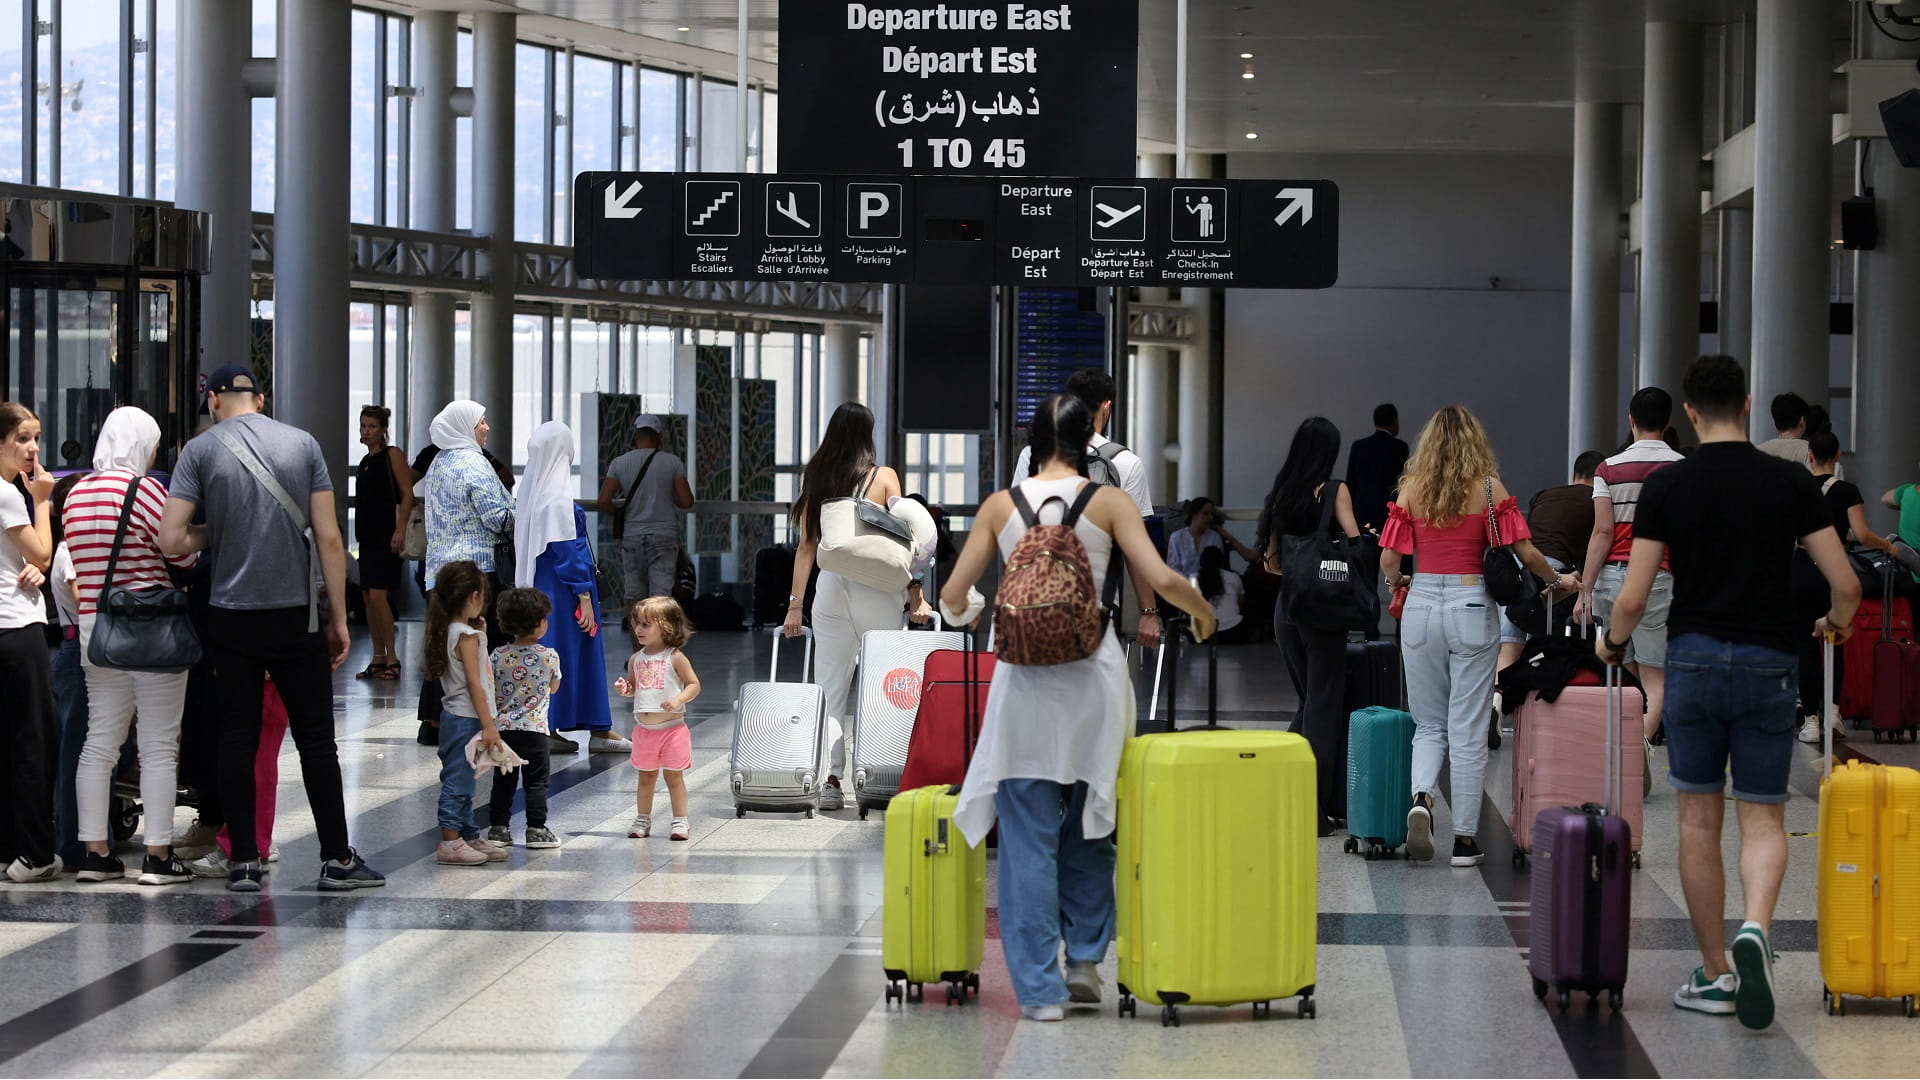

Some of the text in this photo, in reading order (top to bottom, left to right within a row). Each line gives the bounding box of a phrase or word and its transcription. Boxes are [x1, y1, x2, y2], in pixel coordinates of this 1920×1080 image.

[847, 3, 1072, 36] Departure East
[882, 45, 1038, 79] Départ Est
[875, 86, 1040, 128] ذهاب (شرق)
[897, 137, 1026, 169] 1 TO 45
[1001, 183, 1073, 200] Departure
[1021, 203, 1053, 216] East
[764, 243, 823, 254] قاعة الوصول
[841, 244, 907, 256] مواقف سيارات
[1011, 246, 1061, 260] Départ
[1090, 247, 1146, 259] ذهاب (شرق)
[1165, 248, 1231, 260] تسجيل التذاكر
[698, 252, 727, 262] Stairs
[760, 253, 826, 265] Arrival Lobby
[856, 255, 892, 266] Parking
[1081, 257, 1154, 269] Departure East
[691, 263, 734, 273] Escaliers
[757, 264, 830, 275] Salle d'Arrivée
[1177, 259, 1219, 269] Check-In
[1024, 265, 1048, 278] Est
[1128, 269, 1145, 278] Est
[1161, 269, 1235, 281] Enregistrement
[1319, 559, 1349, 573] PUMA
